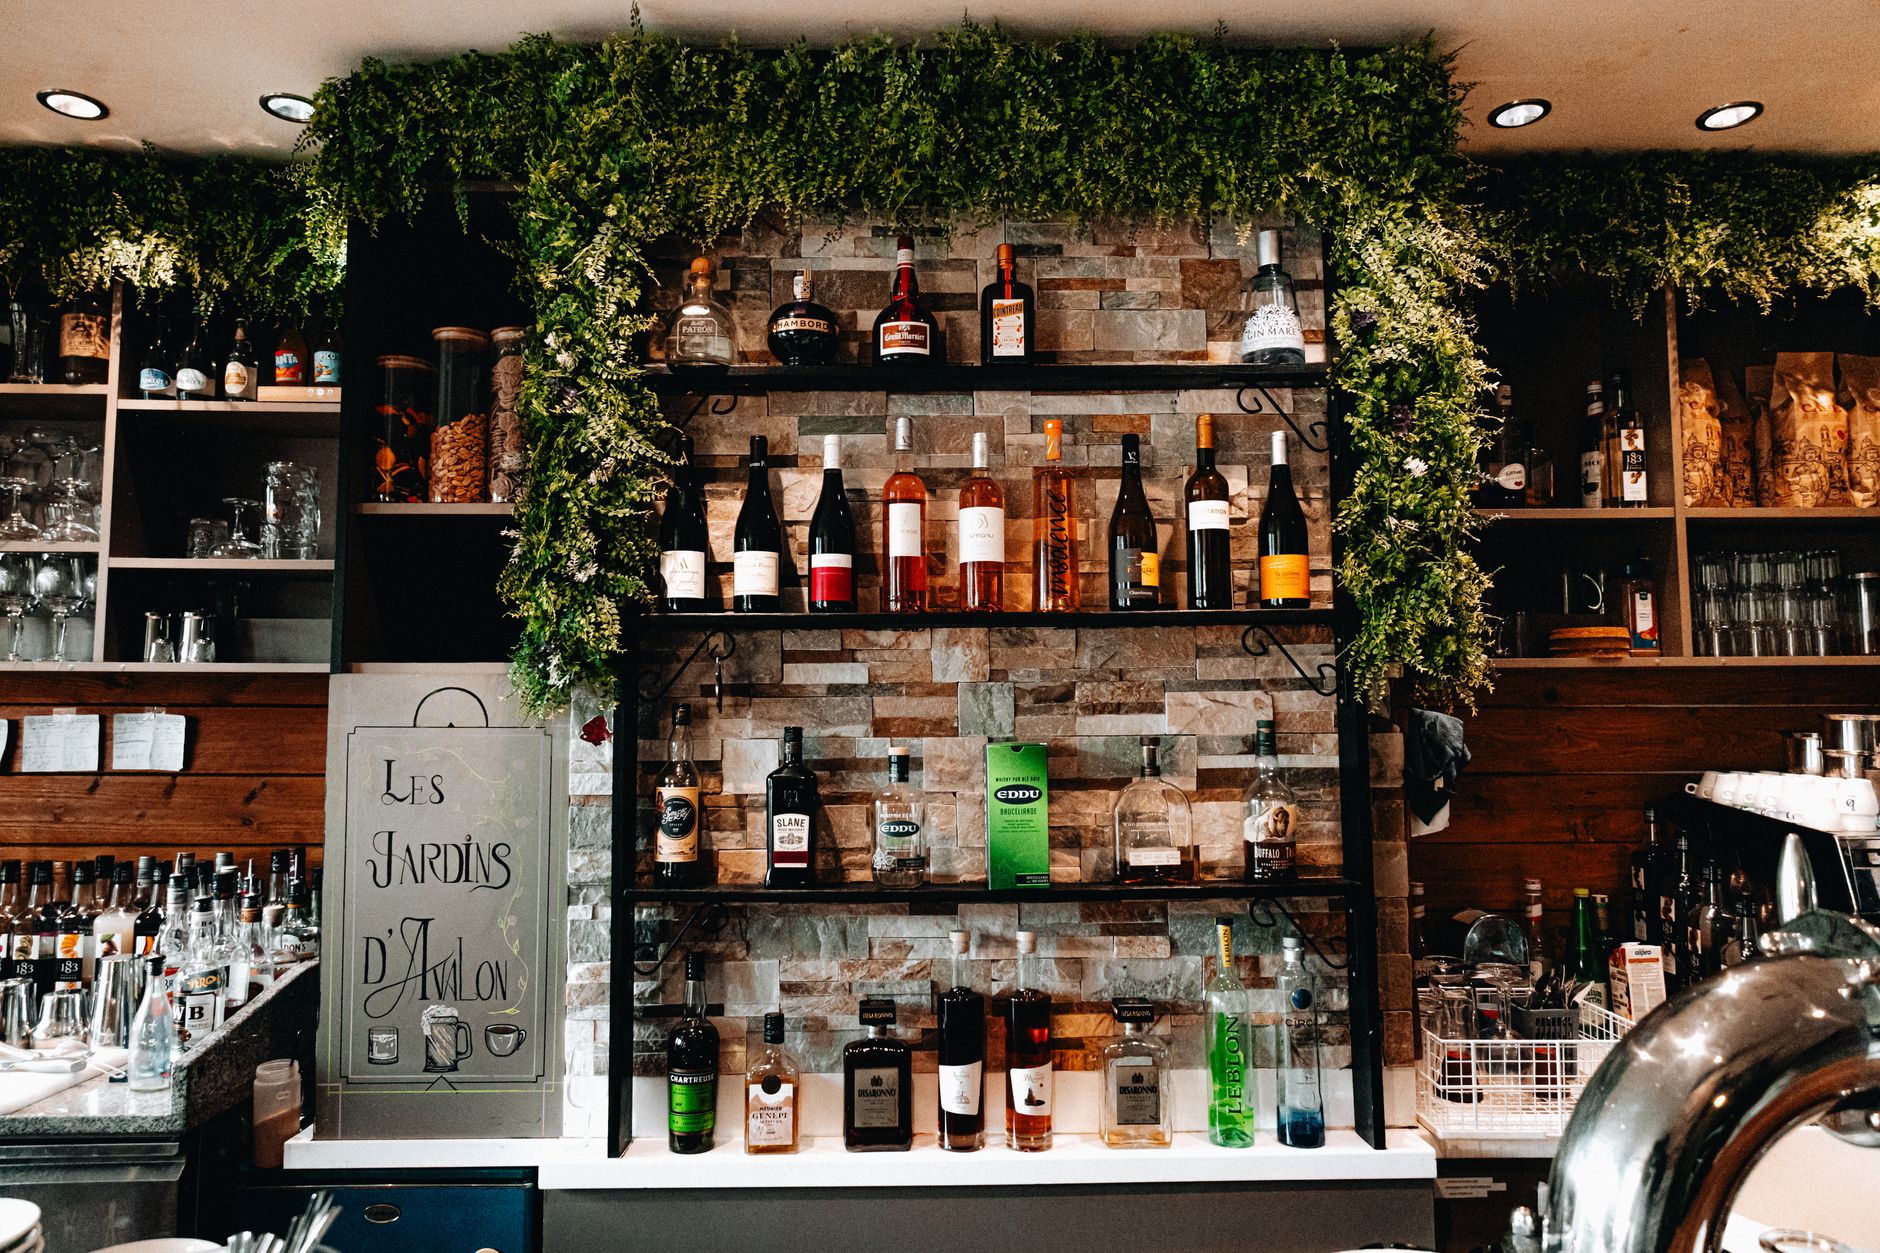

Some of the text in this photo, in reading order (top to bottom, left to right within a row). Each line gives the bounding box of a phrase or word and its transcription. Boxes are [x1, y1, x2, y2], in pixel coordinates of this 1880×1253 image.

[992, 302, 1023, 318] COINTREAU
[771, 317, 829, 332] CHAMBORD
[1247, 327, 1297, 340] GIN MARE
[275, 353, 298, 364] ANTA
[1626, 453, 1642, 465] 183
[1046, 489, 1069, 596] insolence
[776, 818, 806, 828] SLANE
[1634, 949, 1652, 957] alpro
[16, 961, 34, 975] 183
[60, 960, 79, 974] 183
[1226, 1014, 1243, 1114] LEBLON
[670, 1073, 715, 1084] CHARTREUSE
[857, 1088, 896, 1098] DISARONNO
[1119, 1085, 1158, 1095] DISARONNO
